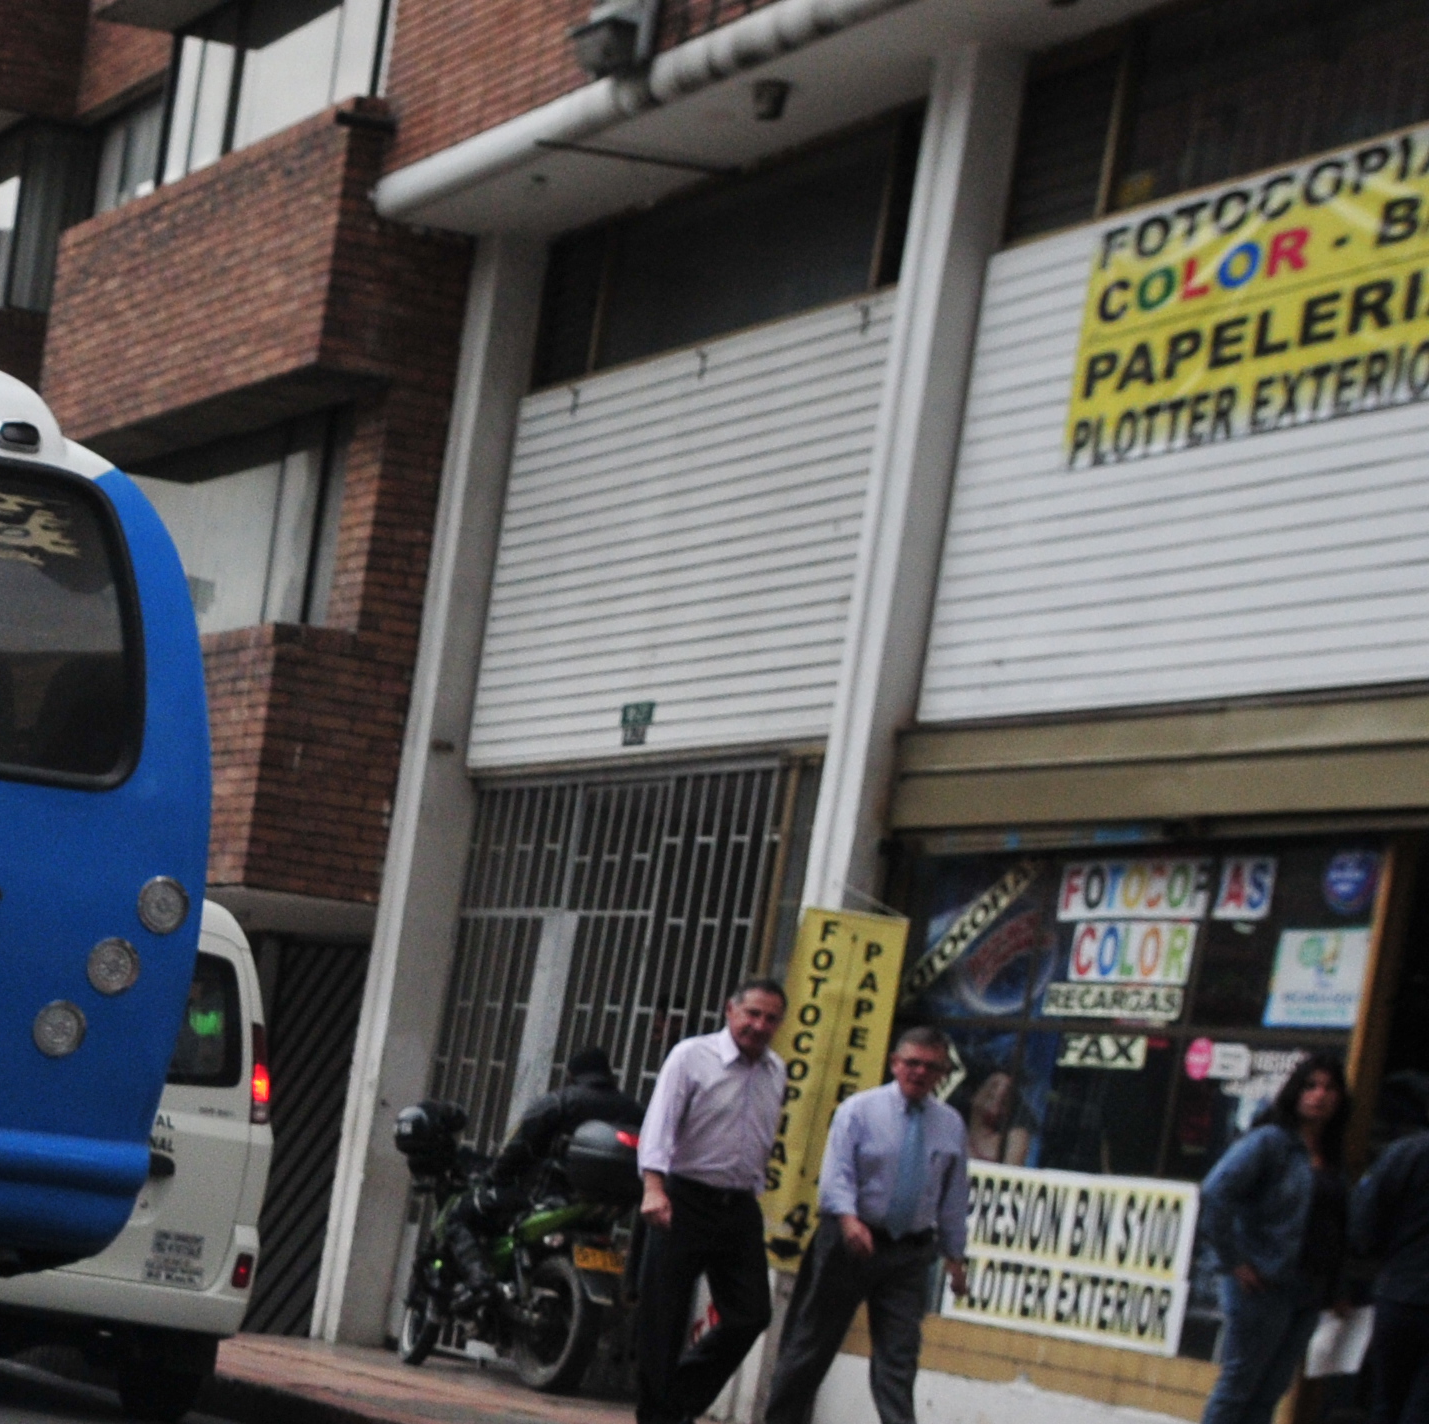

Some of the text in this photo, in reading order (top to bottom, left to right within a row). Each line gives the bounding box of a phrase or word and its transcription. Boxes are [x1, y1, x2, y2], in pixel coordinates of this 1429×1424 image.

[1097, 227, 1311, 323] COLOR
[1375, 196, 1429, 248] B
[1082, 270, 1429, 400] PAPELERI
[1065, 385, 1238, 473] PLOTTER
[1060, 862, 1271, 910] FOTOCOPAS
[1074, 924, 1188, 978] COLOR
[1050, 985, 1182, 1013] RECARGAS
[764, 920, 840, 1192] FOTOCOPIAS
[1065, 1035, 1140, 1063] FAX
[967, 1258, 1173, 1341] LOTTER EXTERIOR
